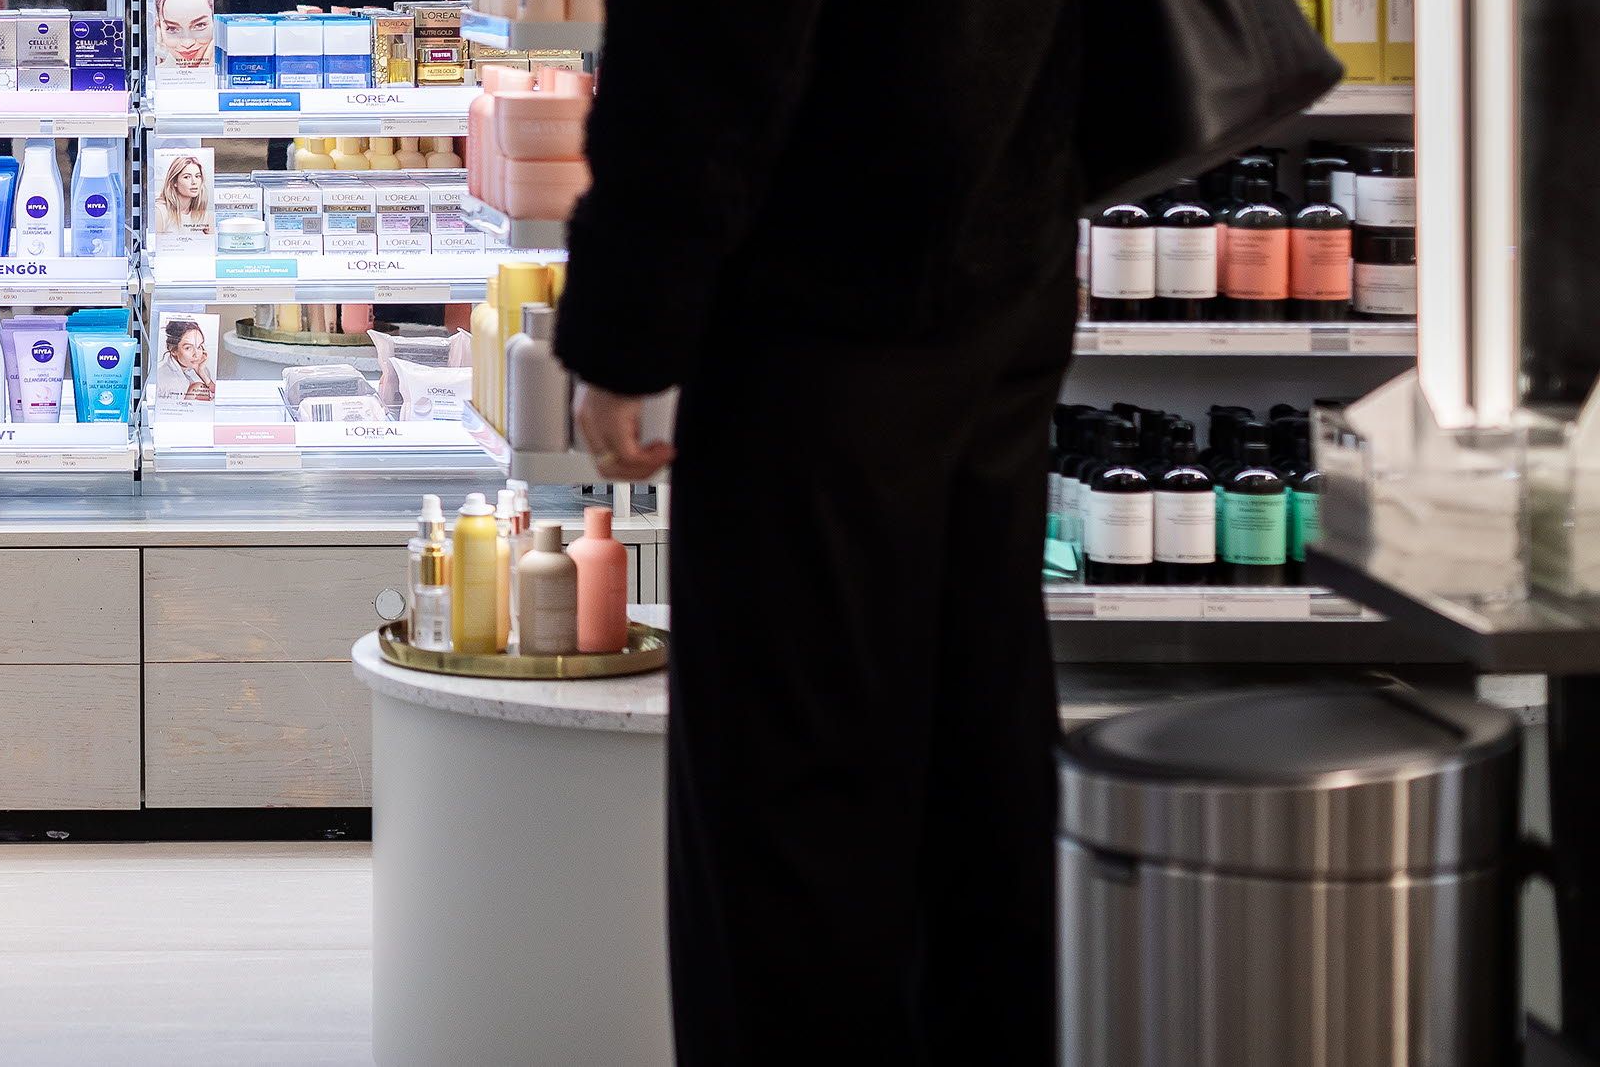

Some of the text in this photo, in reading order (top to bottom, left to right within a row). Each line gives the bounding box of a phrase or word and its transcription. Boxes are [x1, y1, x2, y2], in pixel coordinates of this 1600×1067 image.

[347, 94, 404, 103] L'ORÉAL
[347, 260, 404, 270] L'ORÉAL
[345, 425, 403, 436] L'ORÉAL
